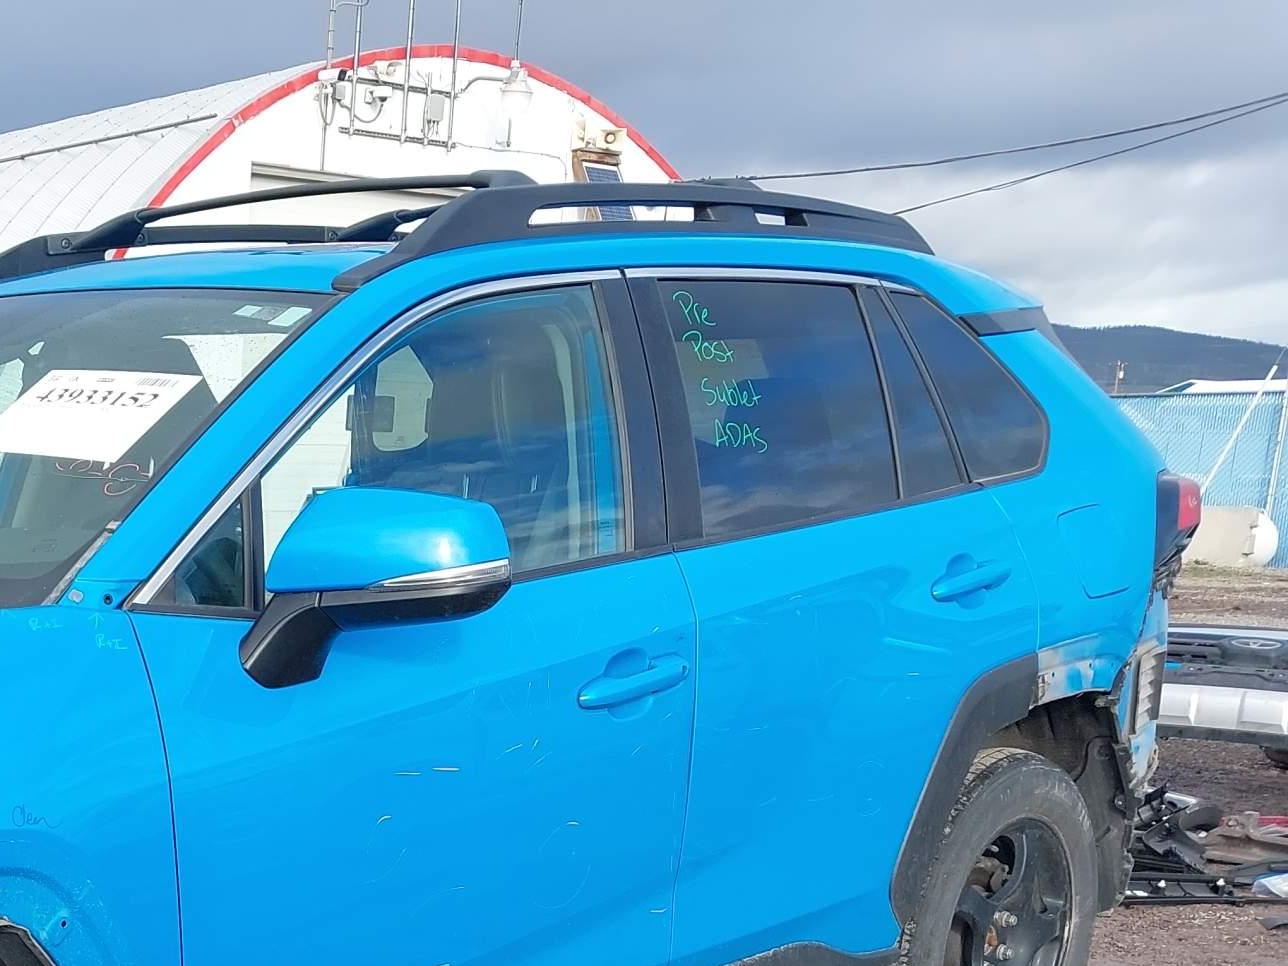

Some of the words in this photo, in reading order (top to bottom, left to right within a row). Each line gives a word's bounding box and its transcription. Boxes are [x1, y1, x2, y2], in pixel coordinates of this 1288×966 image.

[673, 291, 716, 326] Pre
[682, 330, 734, 363] Post
[36, 387, 160, 408] 43933152
[701, 378, 762, 407] Sublet
